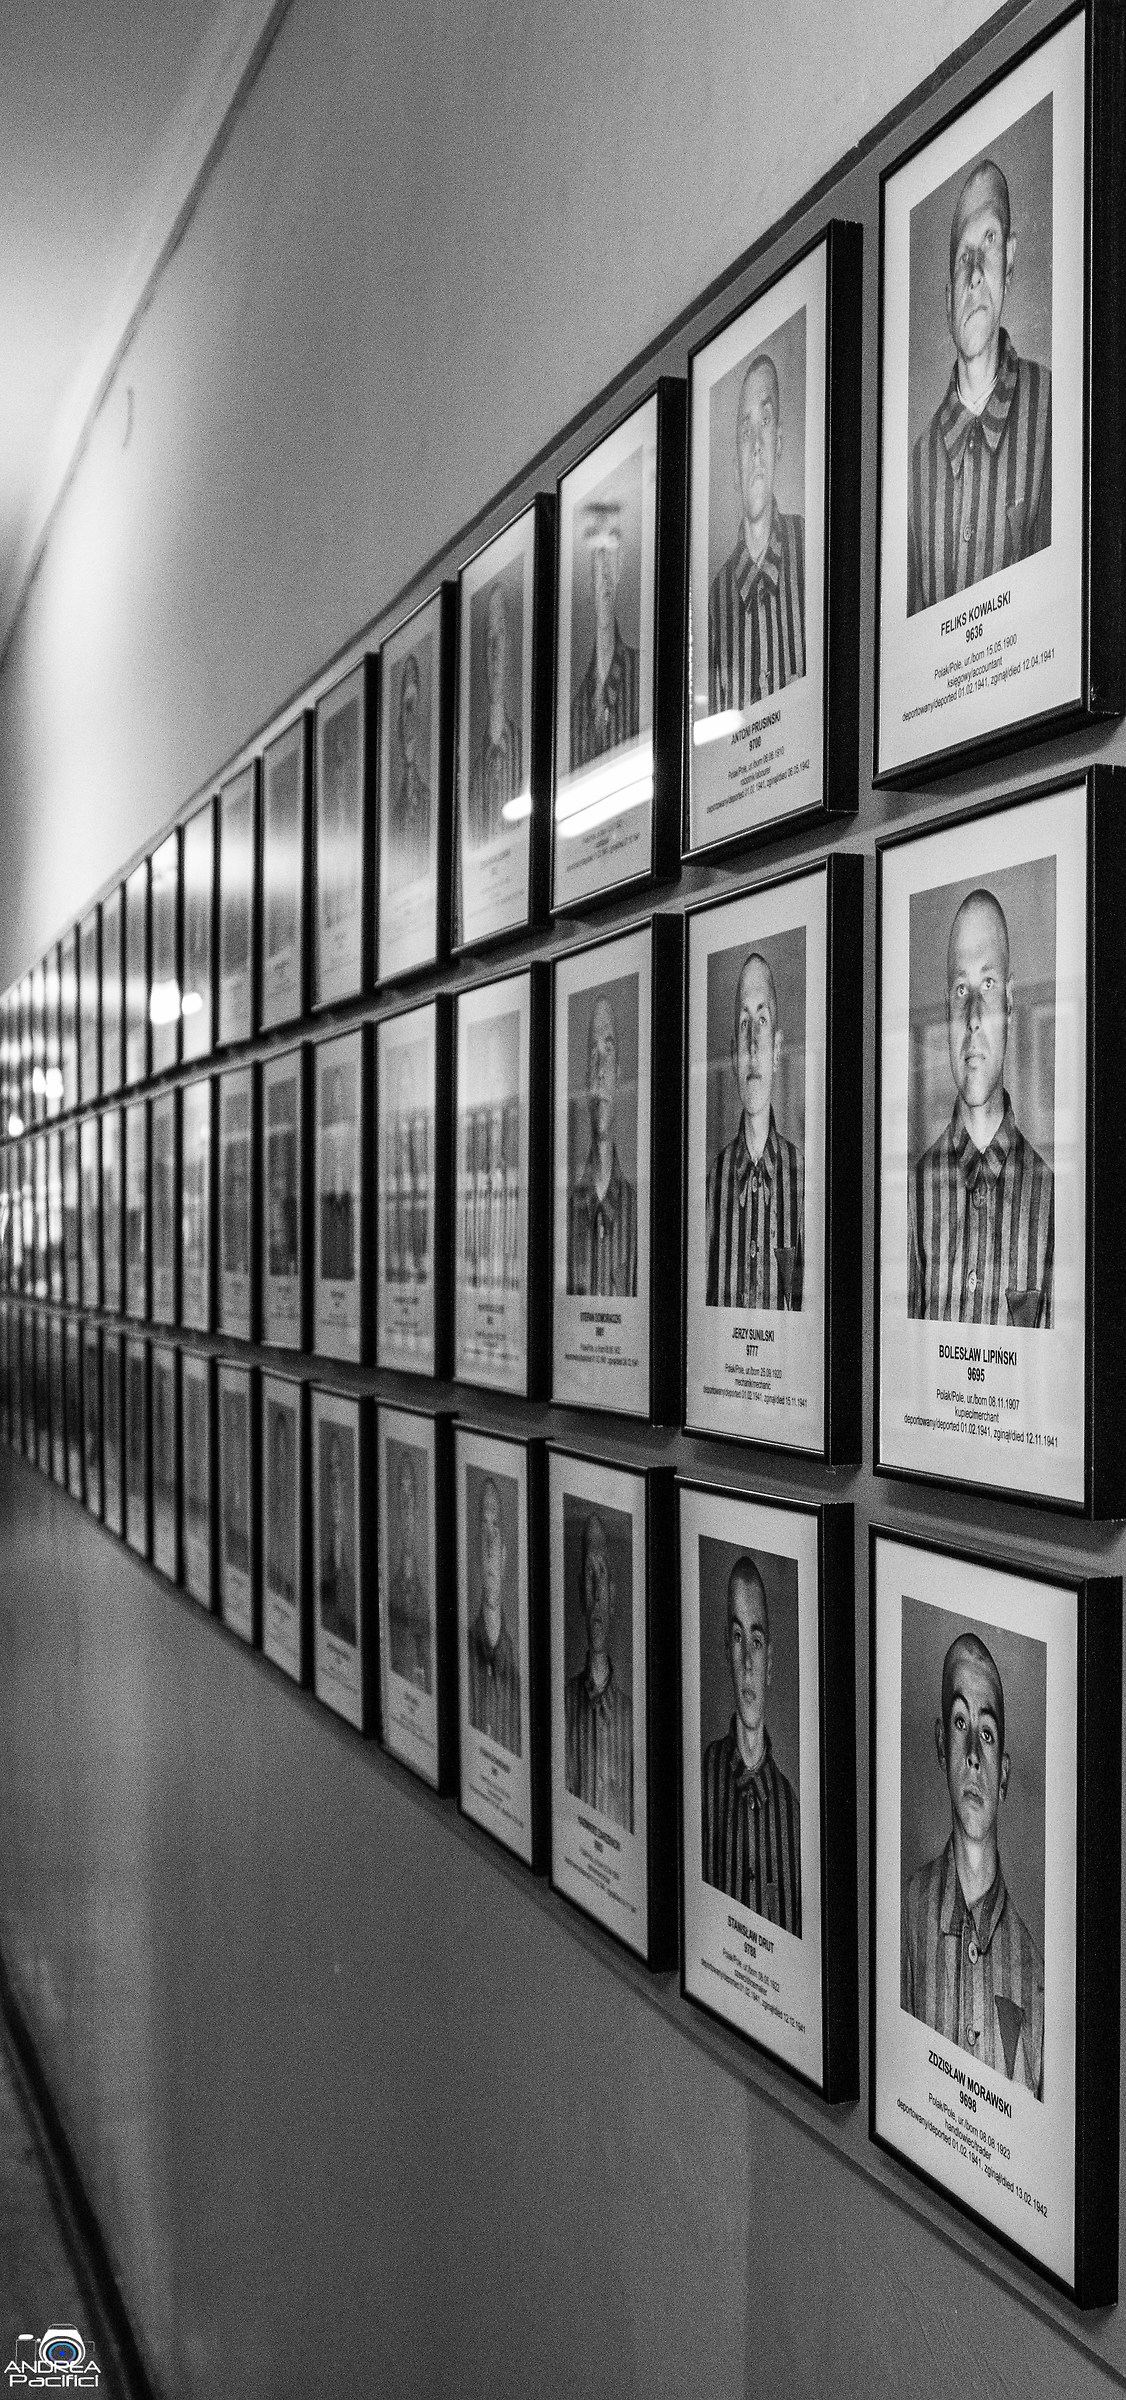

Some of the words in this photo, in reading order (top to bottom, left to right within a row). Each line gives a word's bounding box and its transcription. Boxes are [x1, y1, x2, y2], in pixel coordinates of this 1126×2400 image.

[940, 612, 967, 636] FELIKS
[968, 590, 1011, 623] KOWALSKI
[965, 623, 983, 643] 9636
[902, 689, 958, 722] deportowany/deported
[958, 677, 990, 698] 01.02.1941,
[1023, 647, 1055, 671] 12.04.1941
[732, 1327, 748, 1340] JERZY
[746, 1344, 758, 1356] 9777
[938, 1344, 981, 1362] BOLESŁAW
[983, 1347, 1017, 1366] LIPIŃSKI
[967, 1367, 985, 1382] 9695
[955, 1406, 999, 1423] kupiec/merchant
[904, 1414, 960, 1432] deportowany/deported
[960, 1422, 992, 1438] 01.02.1941,
[1026, 1432, 1058, 1447] 12.11.1941
[758, 1935, 774, 1954] DRUT
[928, 2050, 966, 2087] ZDZISŁAW
[967, 2076, 1012, 2118] MORAWSKI
[959, 2090, 977, 2113] 9698
[945, 2118, 991, 2160] handlowiec/trader
[897, 2098, 951, 2146] deportowany/deported
[952, 2138, 983, 2171] 01.02.1941,
[1015, 2186, 1048, 2218] 13.02.1942
